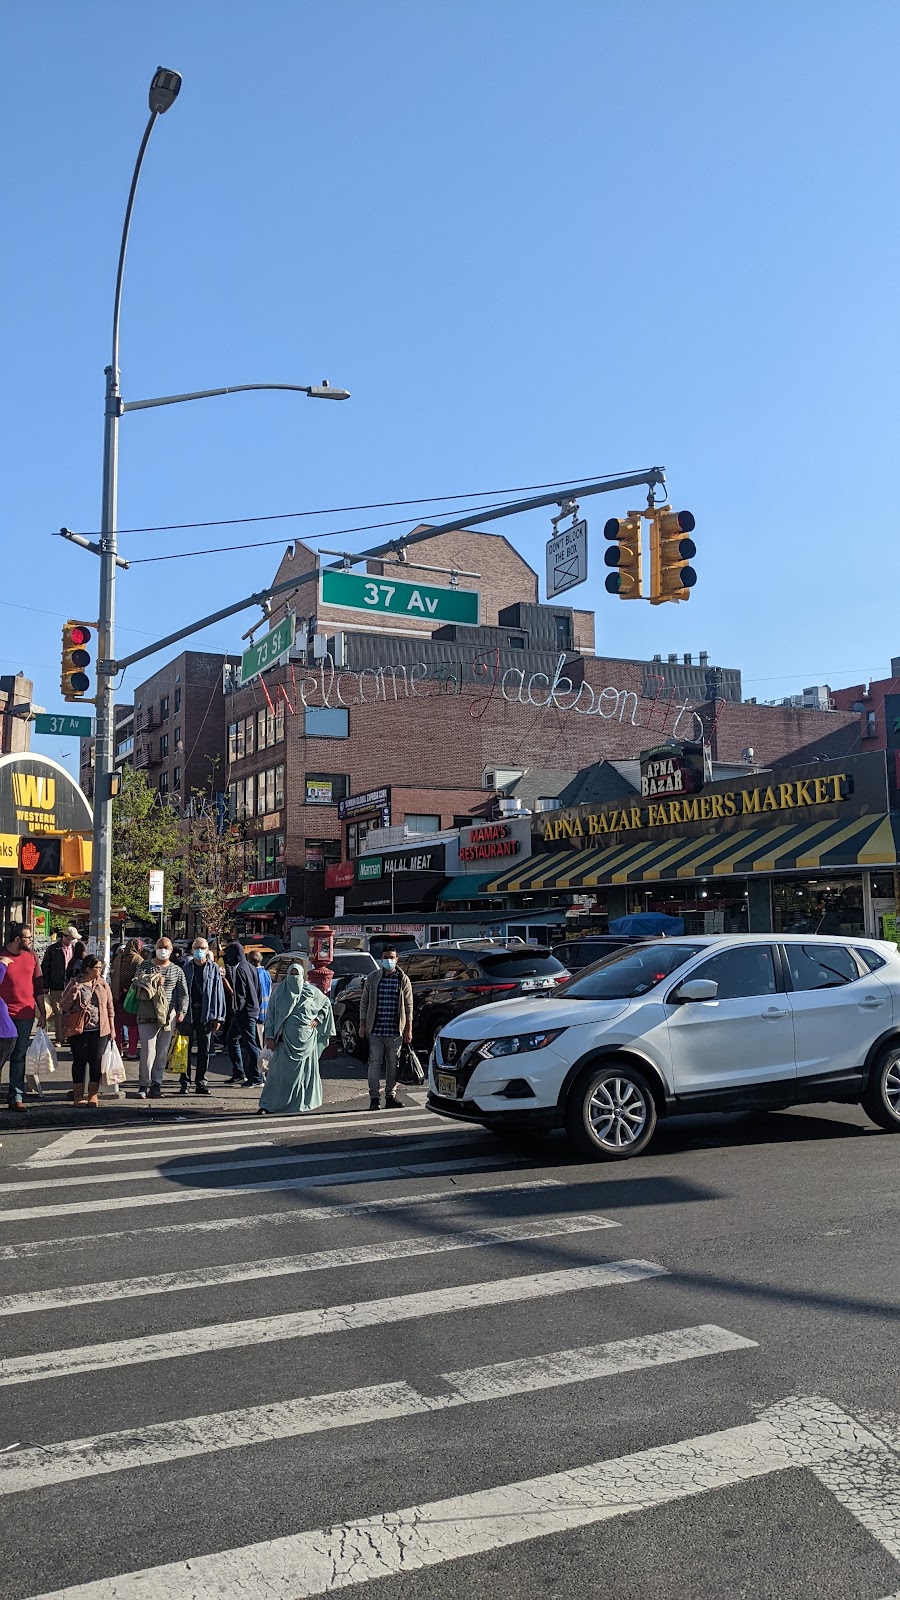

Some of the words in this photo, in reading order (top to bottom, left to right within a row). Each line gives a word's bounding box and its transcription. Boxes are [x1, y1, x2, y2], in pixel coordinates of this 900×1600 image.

[548, 537, 564, 555] DON'T
[565, 528, 584, 547] BLOCK
[554, 551, 566, 564] THE
[566, 544, 578, 560] BOX
[363, 582, 396, 607] 37
[406, 590, 440, 614] Av
[256, 645, 268, 666] 73
[271, 631, 282, 655] St
[470, 648, 640, 727] Jackson
[49, 717, 66, 733] 37
[69, 719, 80, 729] Av
[647, 759, 674, 779] APNA
[12, 772, 55, 810] WU
[641, 769, 683, 797] BAZAR
[16, 810, 55, 824] WESTERN
[543, 818, 584, 842] APNA
[587, 808, 642, 836] BAZAR
[647, 792, 737, 828] FARMERS
[740, 773, 847, 814] MARKET
[469, 824, 507, 843] MAMA'S
[458, 840, 518, 861] RESTAURANT
[360, 863, 381, 876] Mannan
[384, 857, 408, 874] HALAL
[410, 854, 432, 870] MEAT
